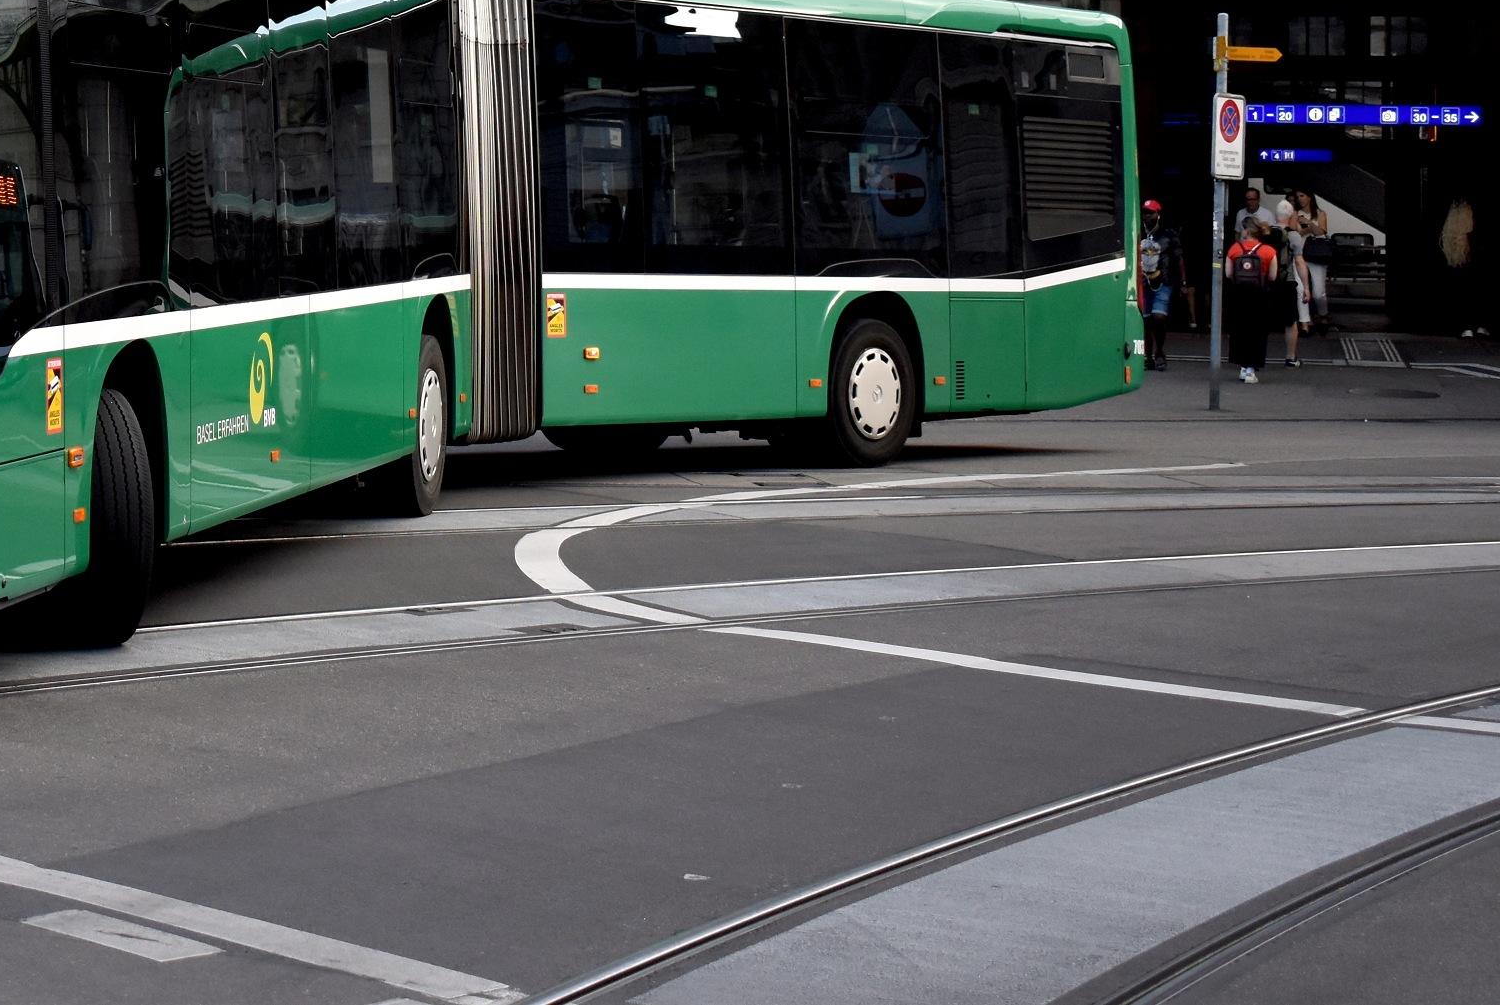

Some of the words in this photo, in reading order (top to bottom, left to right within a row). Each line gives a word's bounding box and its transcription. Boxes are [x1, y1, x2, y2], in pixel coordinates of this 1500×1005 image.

[1278, 111, 1292, 121] 20
[1413, 113, 1427, 122] 30
[1443, 113, 1458, 123] 35
[263, 407, 276, 427] BVB
[196, 423, 217, 445] BASEL
[217, 414, 249, 439] ERFAHREN
